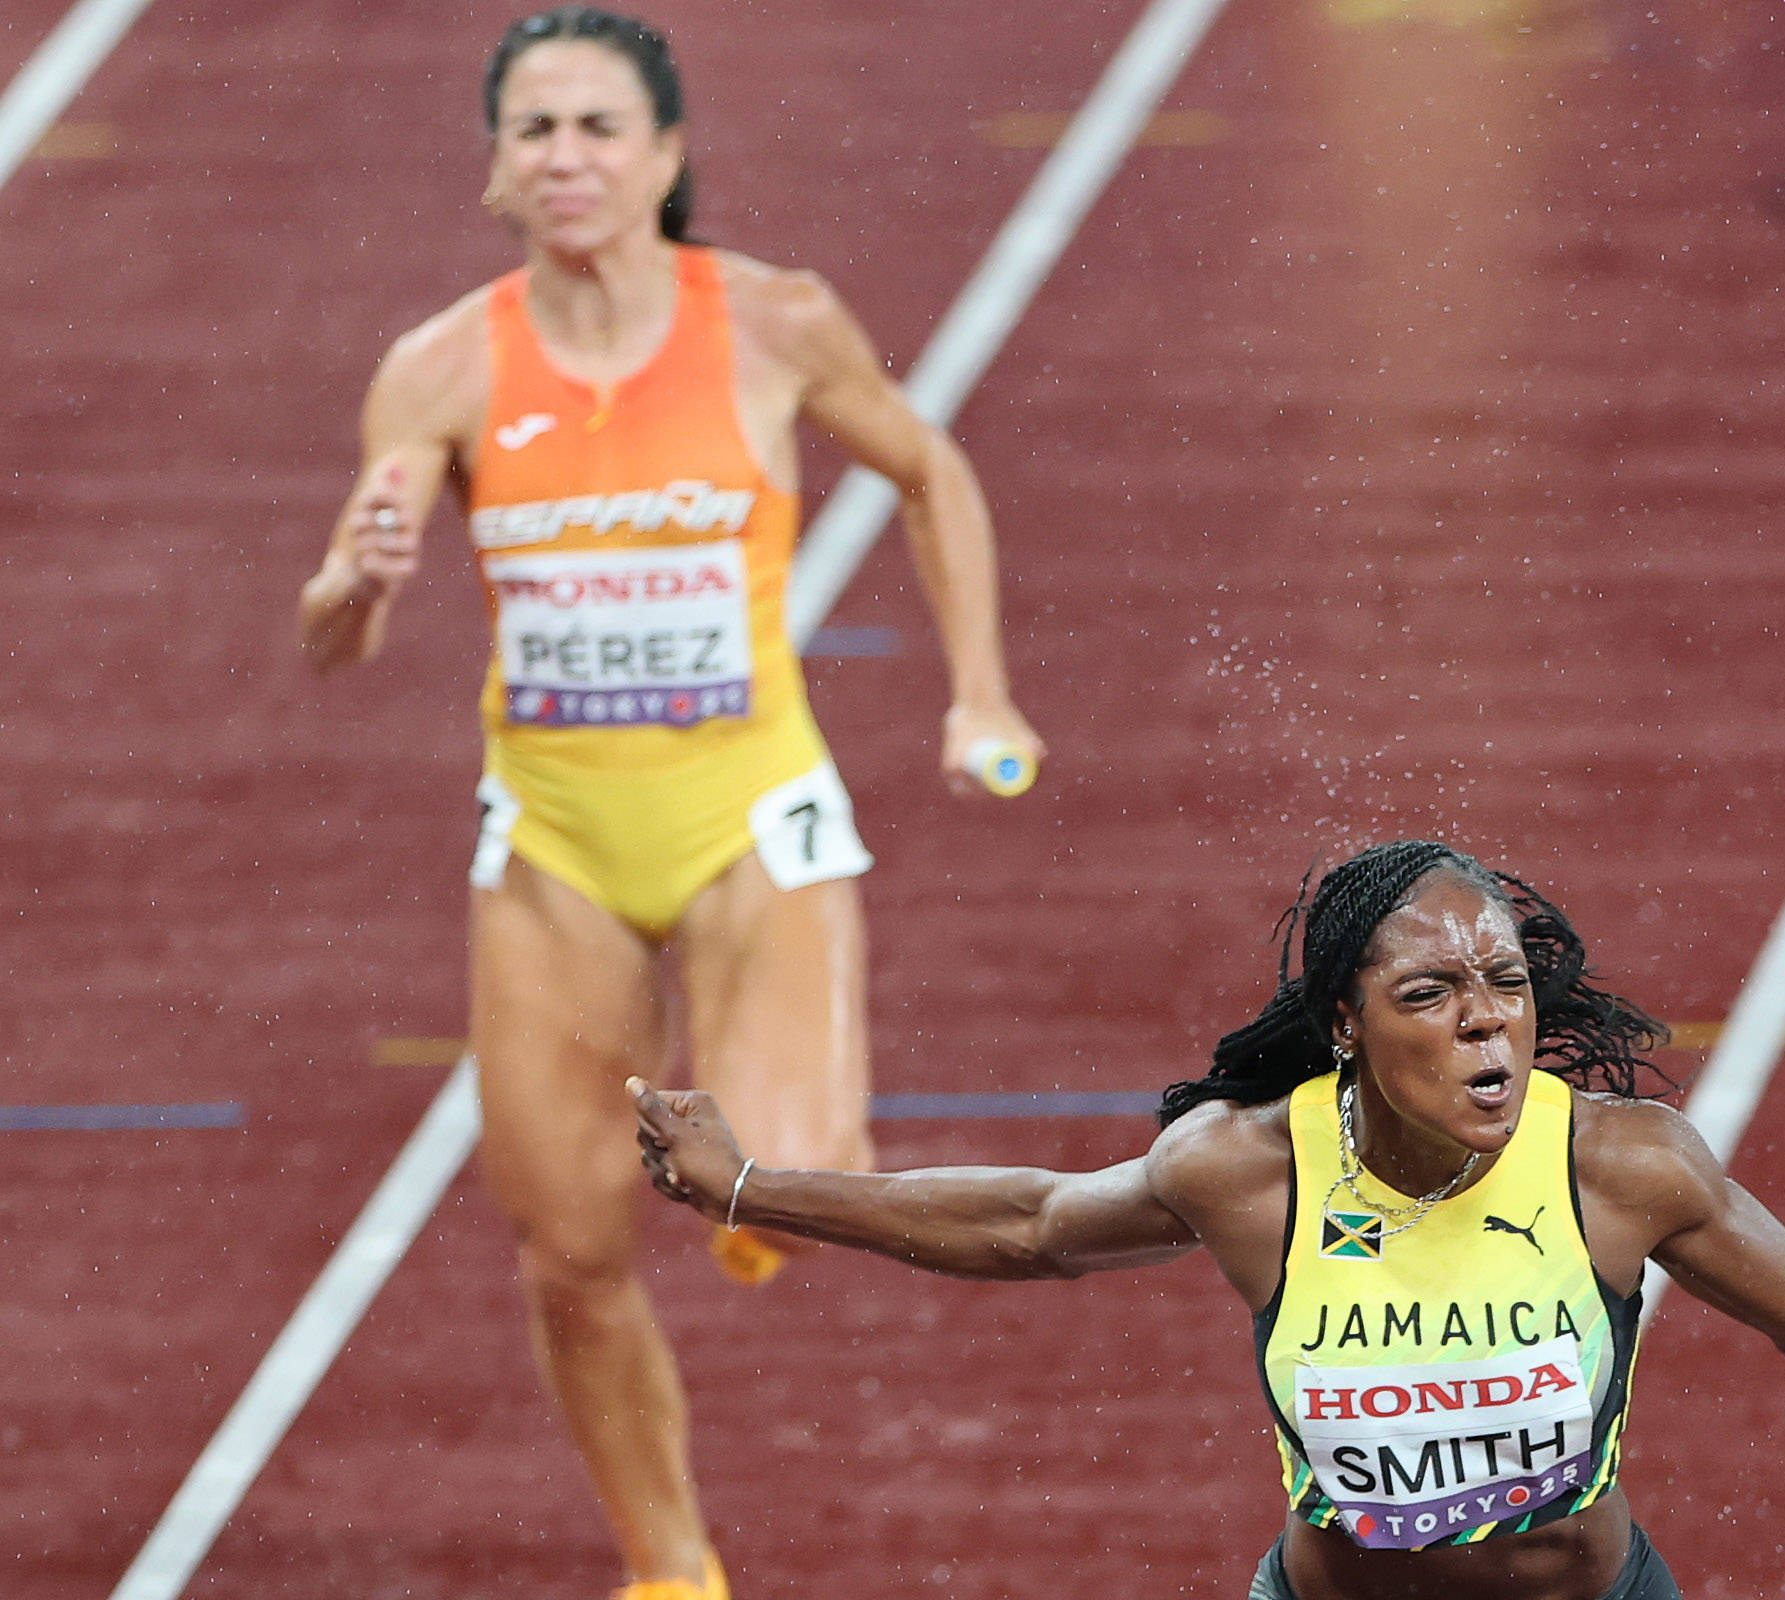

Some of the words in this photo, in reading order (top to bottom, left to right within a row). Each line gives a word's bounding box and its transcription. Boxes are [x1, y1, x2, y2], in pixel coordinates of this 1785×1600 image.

[520, 621, 723, 678] PÉREZ
[784, 801, 818, 862] 7
[1301, 1300, 1581, 1351] JAMAICA
[1303, 1363, 1577, 1420] HONDA
[1332, 1421, 1565, 1496] SMITH
